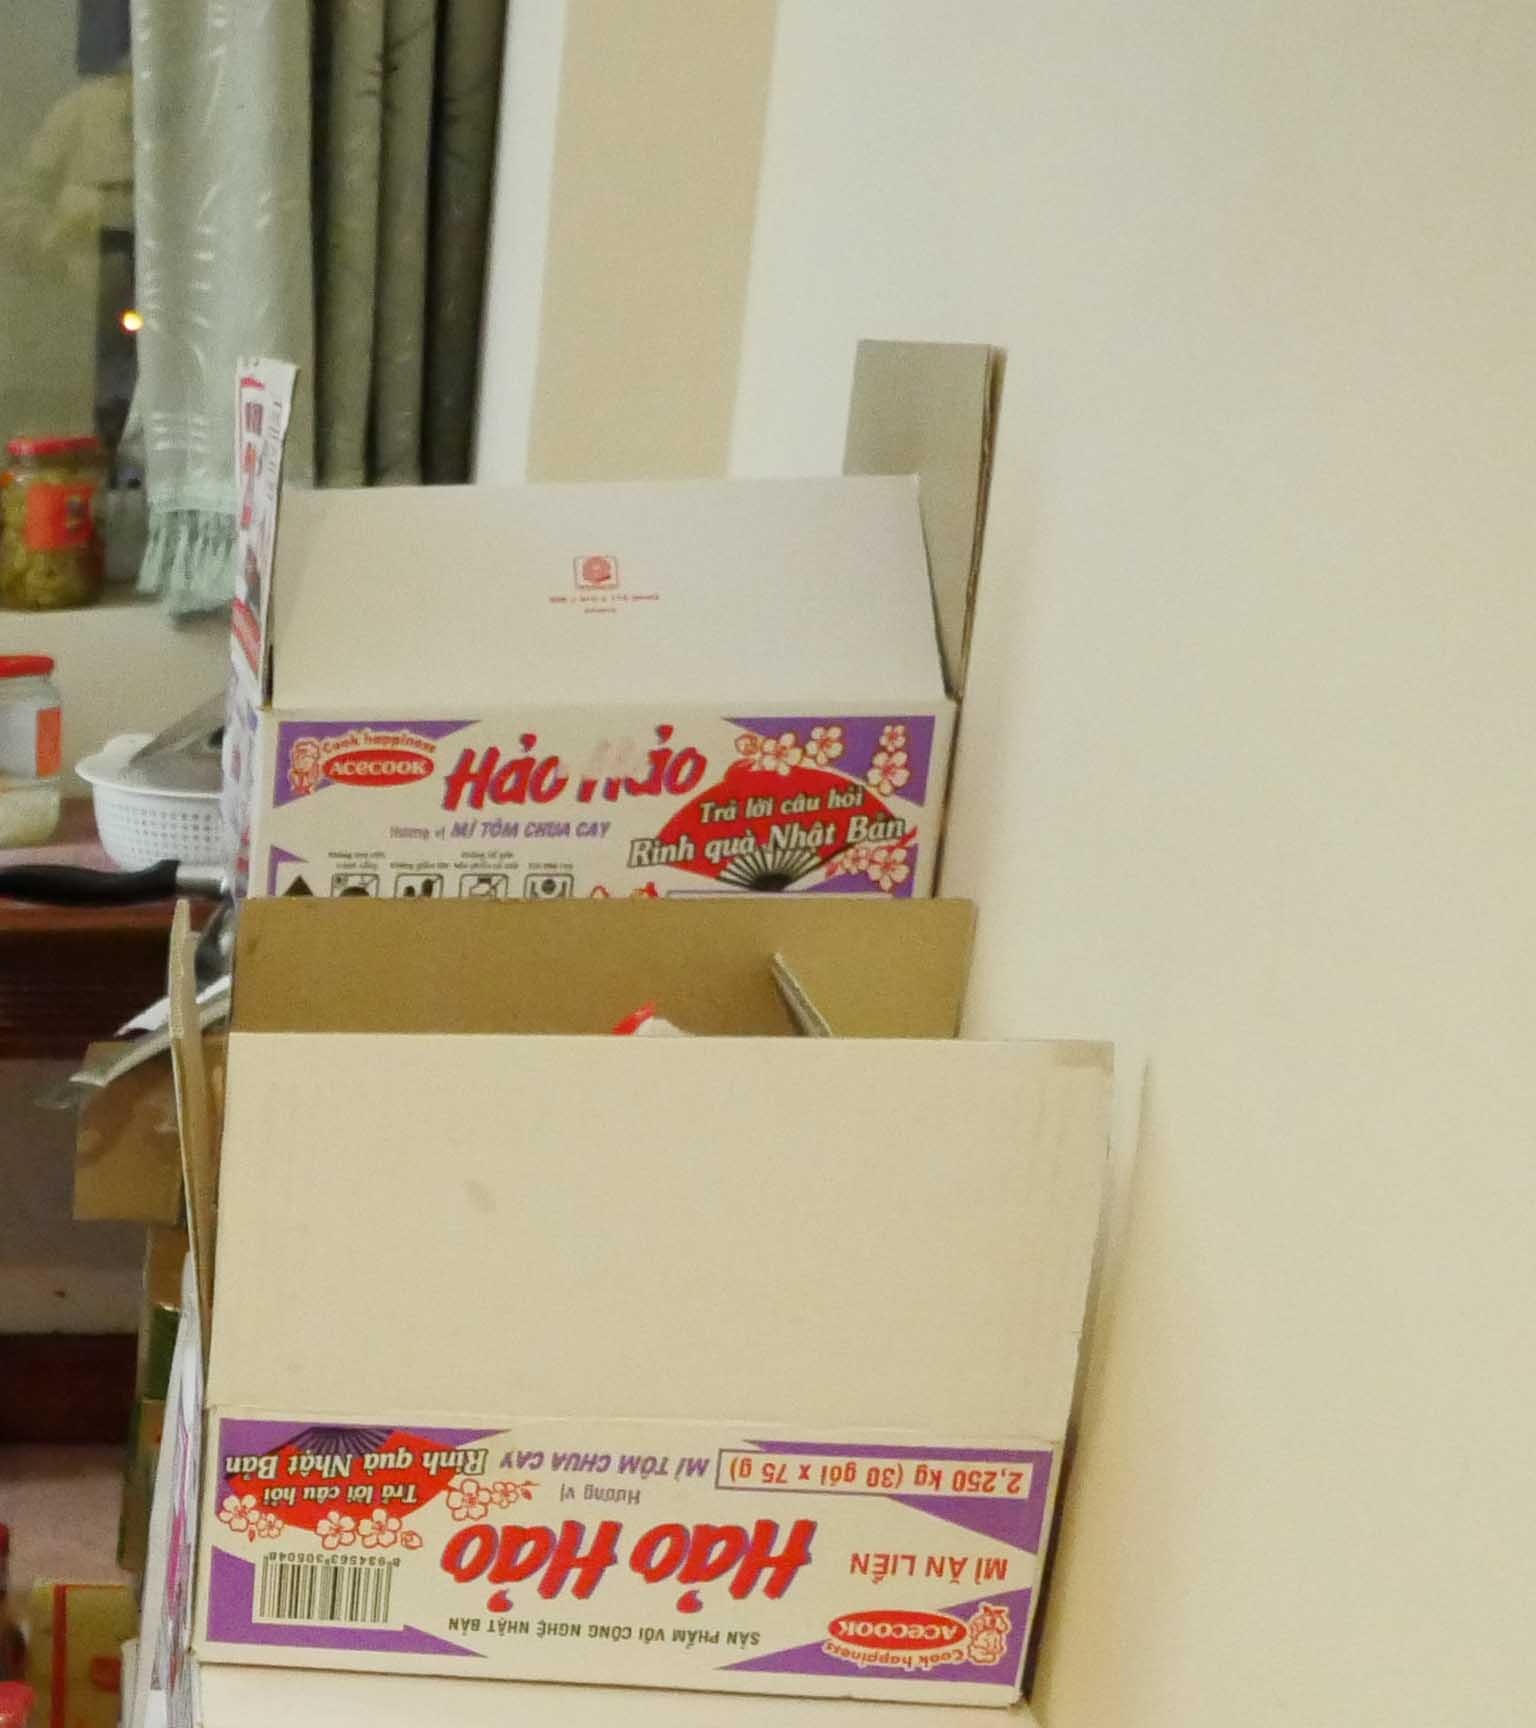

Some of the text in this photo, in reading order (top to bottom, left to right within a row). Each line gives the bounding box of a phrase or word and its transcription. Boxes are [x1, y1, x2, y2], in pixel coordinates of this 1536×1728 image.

[441, 733, 571, 811] Hảo
[781, 796, 821, 814] câu
[575, 820, 611, 838] CAY
[225, 1453, 280, 1482] Bản
[287, 1449, 353, 1481] Nhật
[364, 1448, 413, 1480] quà
[499, 1450, 710, 1481] MÌ TÔM CHUA CAY
[761, 1462, 788, 1484] 75
[799, 1464, 811, 1481] x
[820, 1462, 857, 1486] gói
[867, 1463, 904, 1489] (30
[914, 1465, 942, 1490] kg
[951, 1468, 1025, 1494] 2,250
[262, 1483, 418, 1507] Trả lời câu hỏi
[583, 1485, 642, 1506] Hương
[439, 1519, 818, 1615] Hảo Hảo
[849, 1552, 1008, 1586] MÌ ĂN LIỀN
[448, 1616, 761, 1650] SẢN PHẨM VỚI CÔNG NGHỆ NHẬT BẢN
[822, 1641, 965, 1669] Cook happiness
